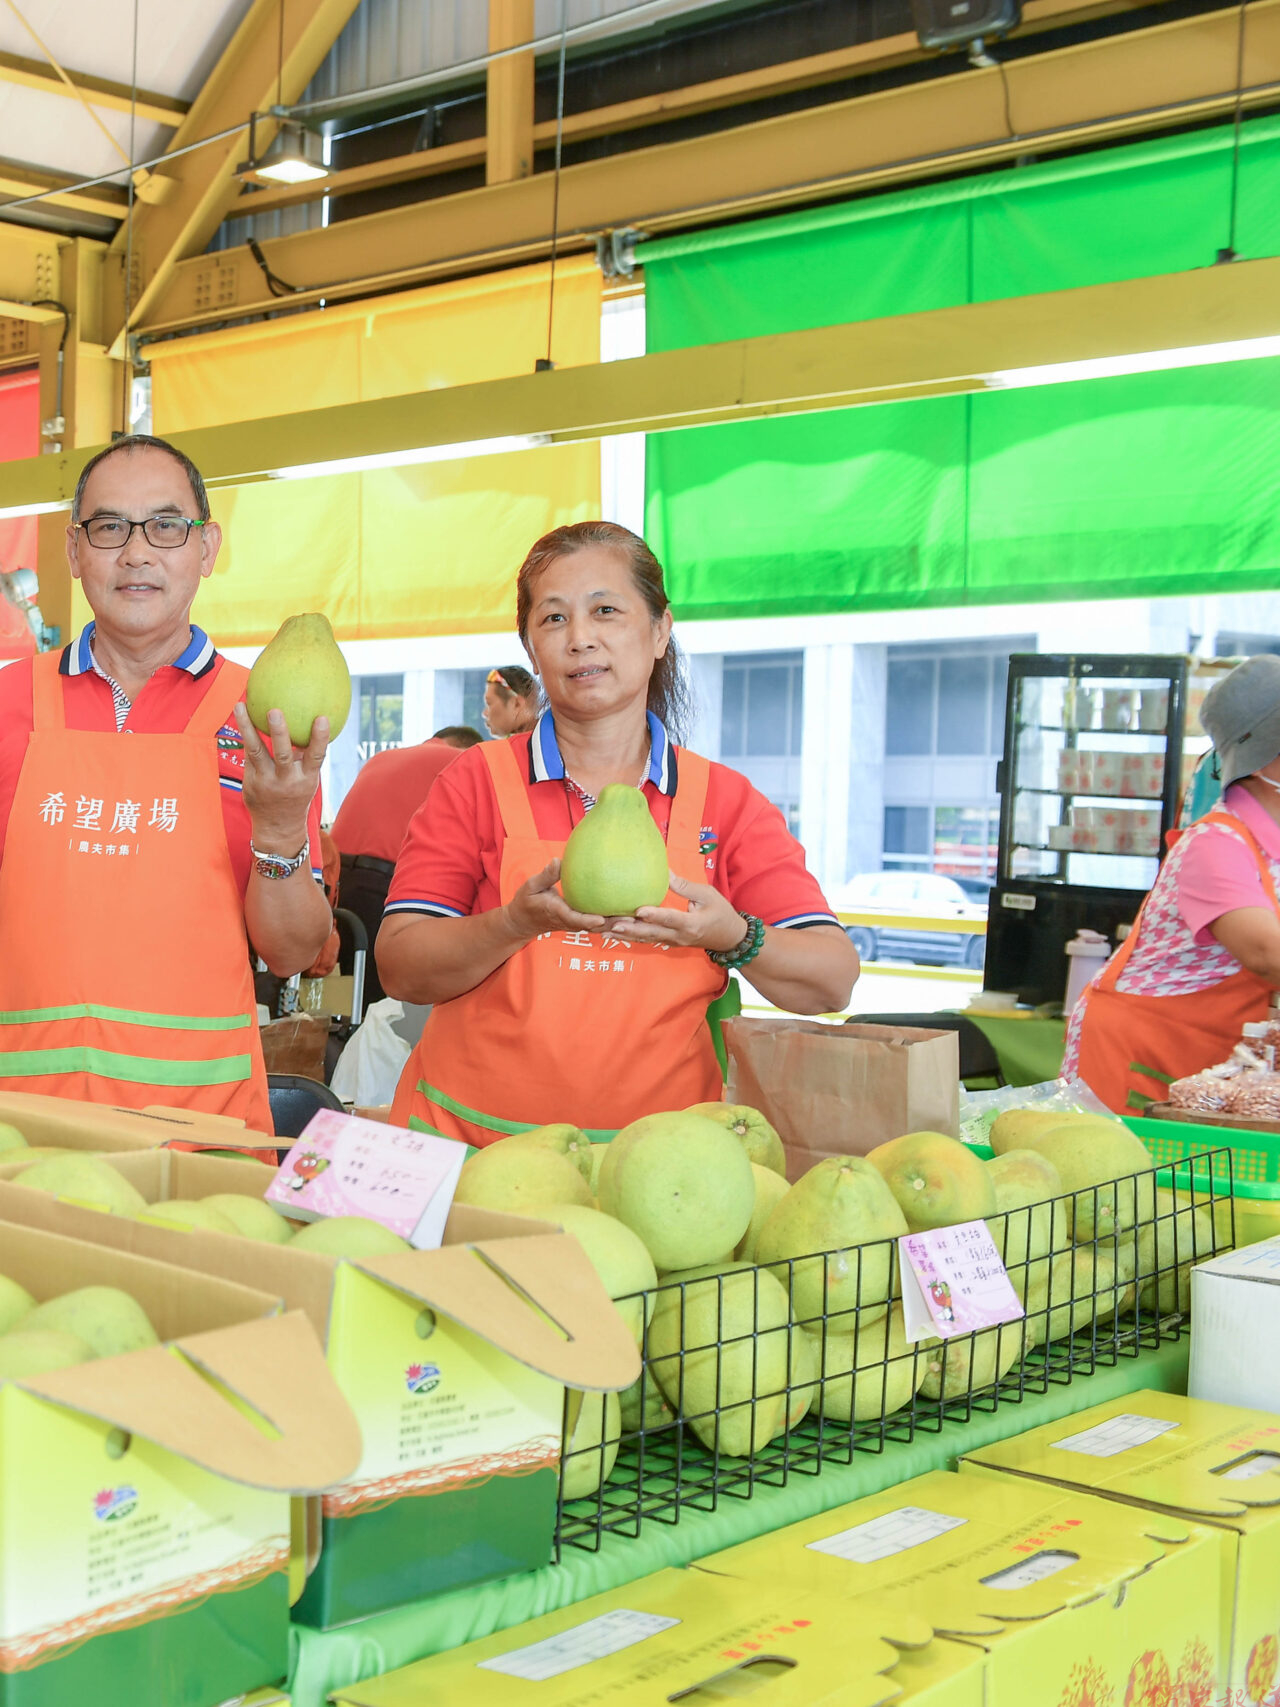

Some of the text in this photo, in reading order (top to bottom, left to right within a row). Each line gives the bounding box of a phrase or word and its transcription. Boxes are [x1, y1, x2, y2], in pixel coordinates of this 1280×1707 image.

[38, 791, 179, 834] 希望廣場
[78, 841, 130, 856] 農夫市集
[569, 958, 625, 972] 農夫市集
